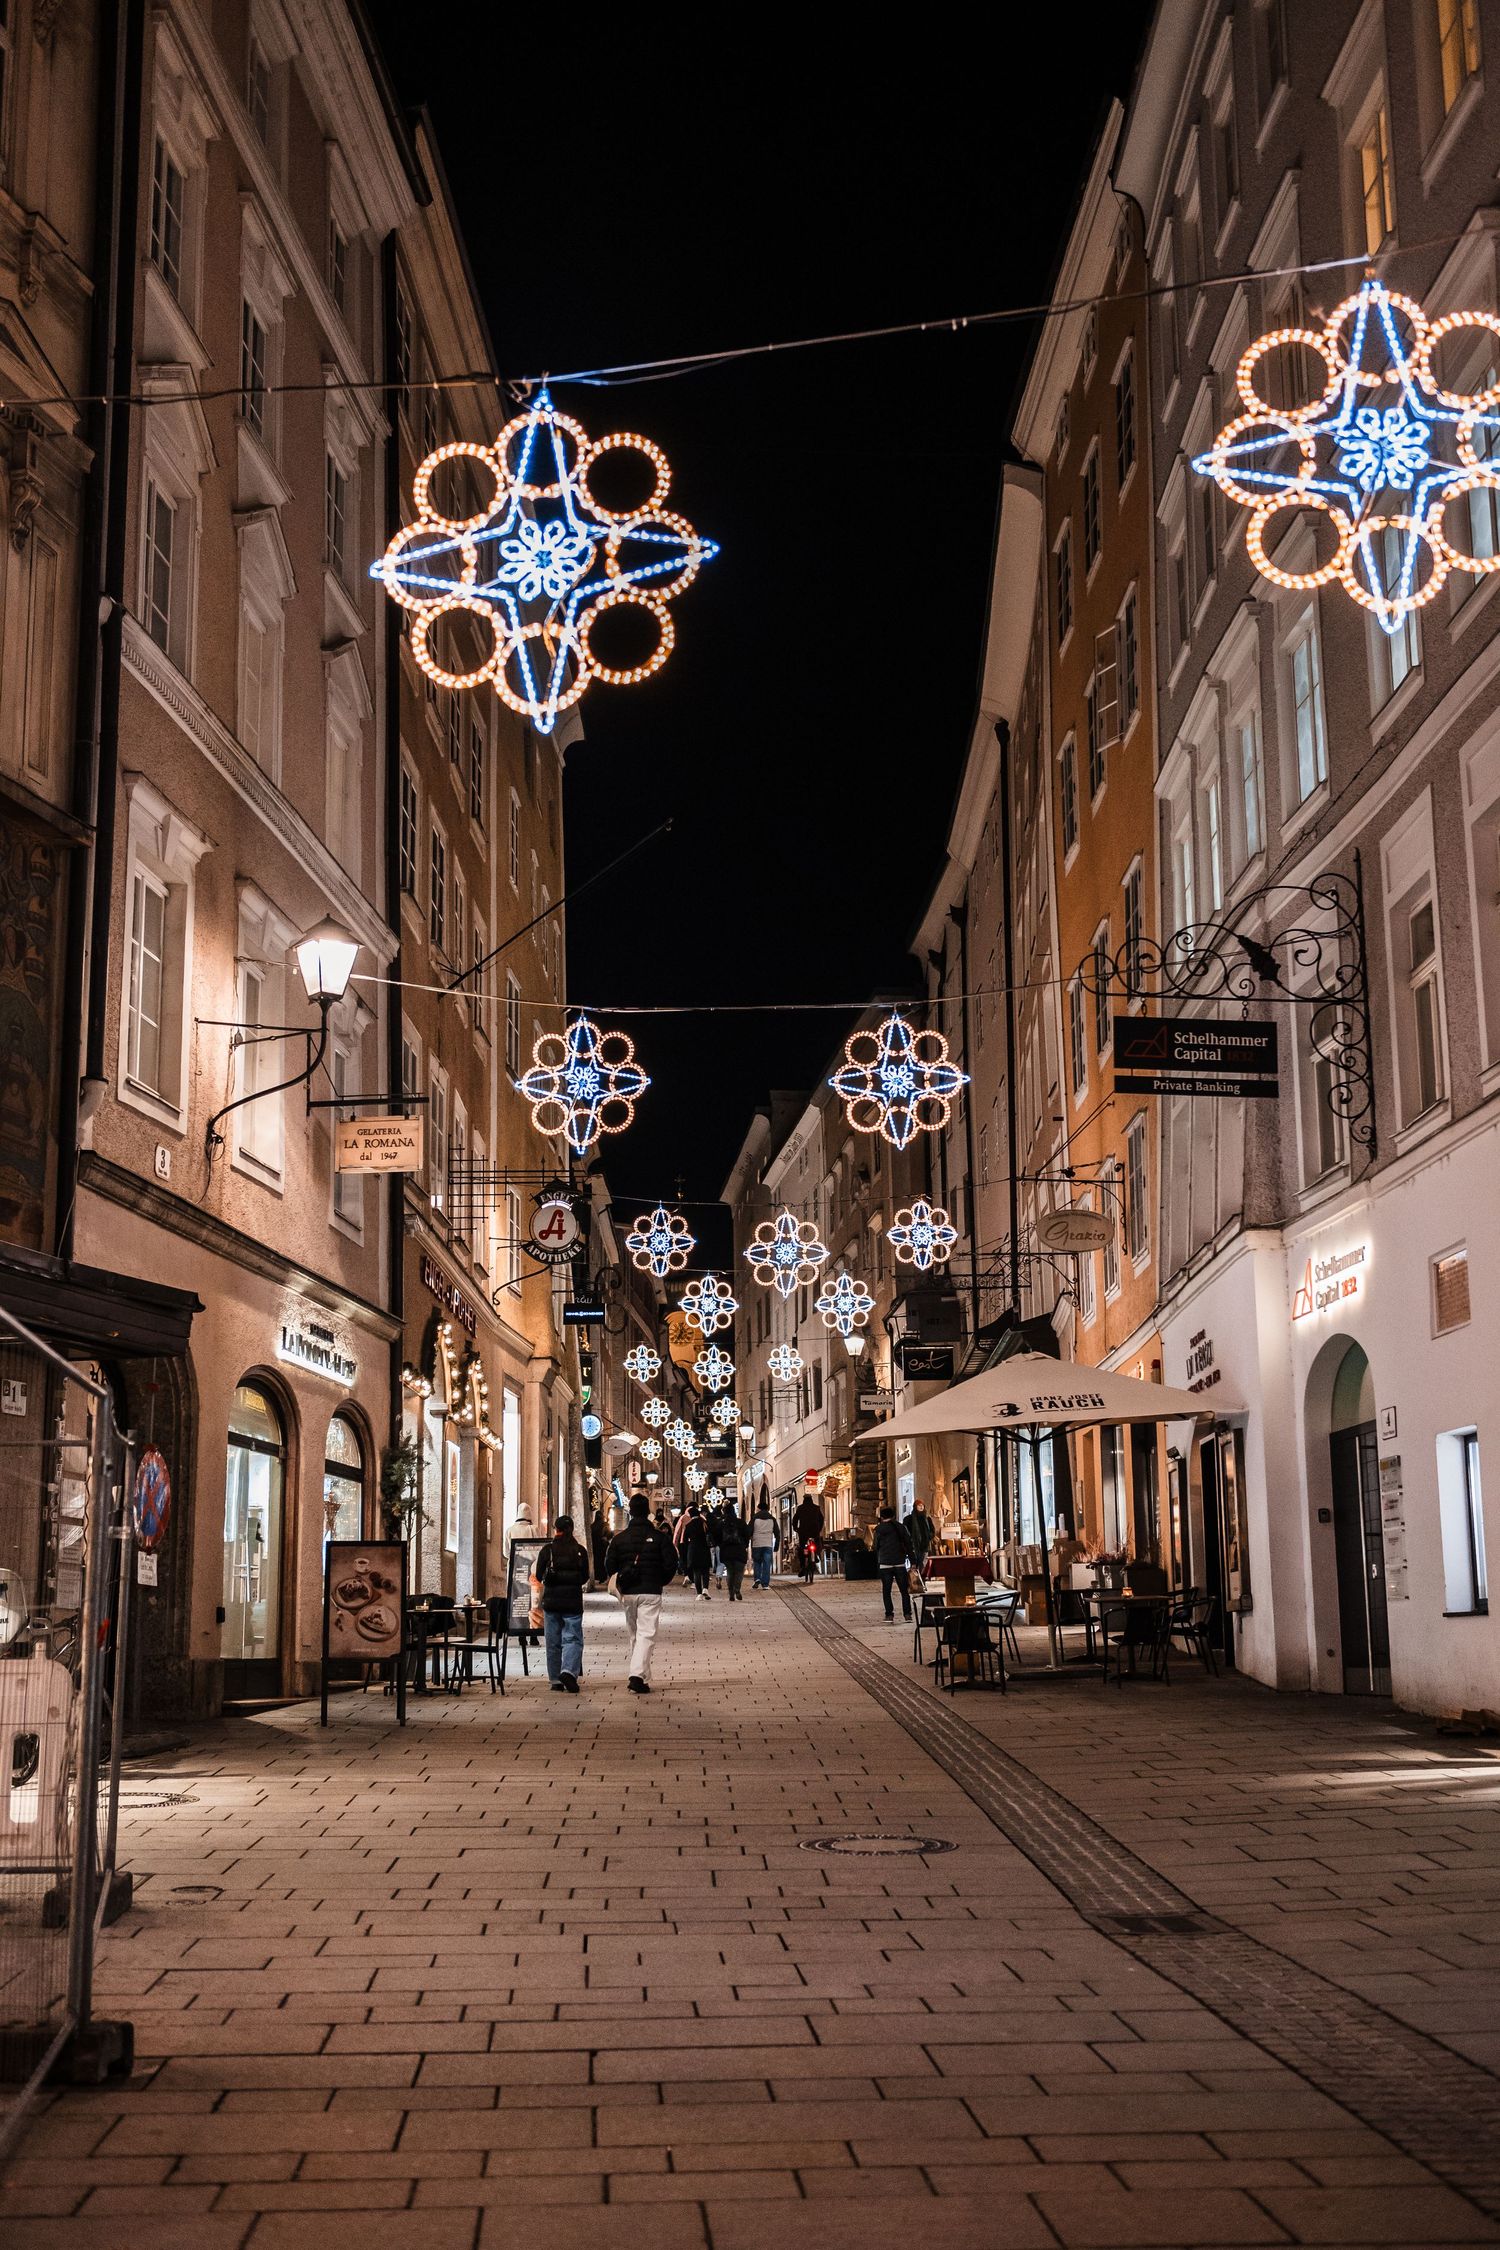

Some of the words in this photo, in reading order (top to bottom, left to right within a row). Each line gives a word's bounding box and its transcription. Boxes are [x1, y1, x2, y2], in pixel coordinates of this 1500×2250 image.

[1174, 1032, 1268, 1047] Schelhammer
[1174, 1047, 1222, 1063] Capital
[1153, 1080, 1193, 1091] Private
[1196, 1082, 1241, 1095] Banking
[357, 1128, 402, 1136] GELATERIA
[344, 1139, 359, 1149] LA
[364, 1138, 415, 1149] ROMANA
[160, 1149, 166, 1169] 3
[360, 1152, 372, 1161] dal
[540, 1191, 573, 1206] ENGEL
[526, 1243, 583, 1263] APOTHEKE
[1068, 1392, 1101, 1400] JOSEF
[1031, 1398, 1105, 1411] RAUCH
[1385, 1411, 1391, 1427] 4
